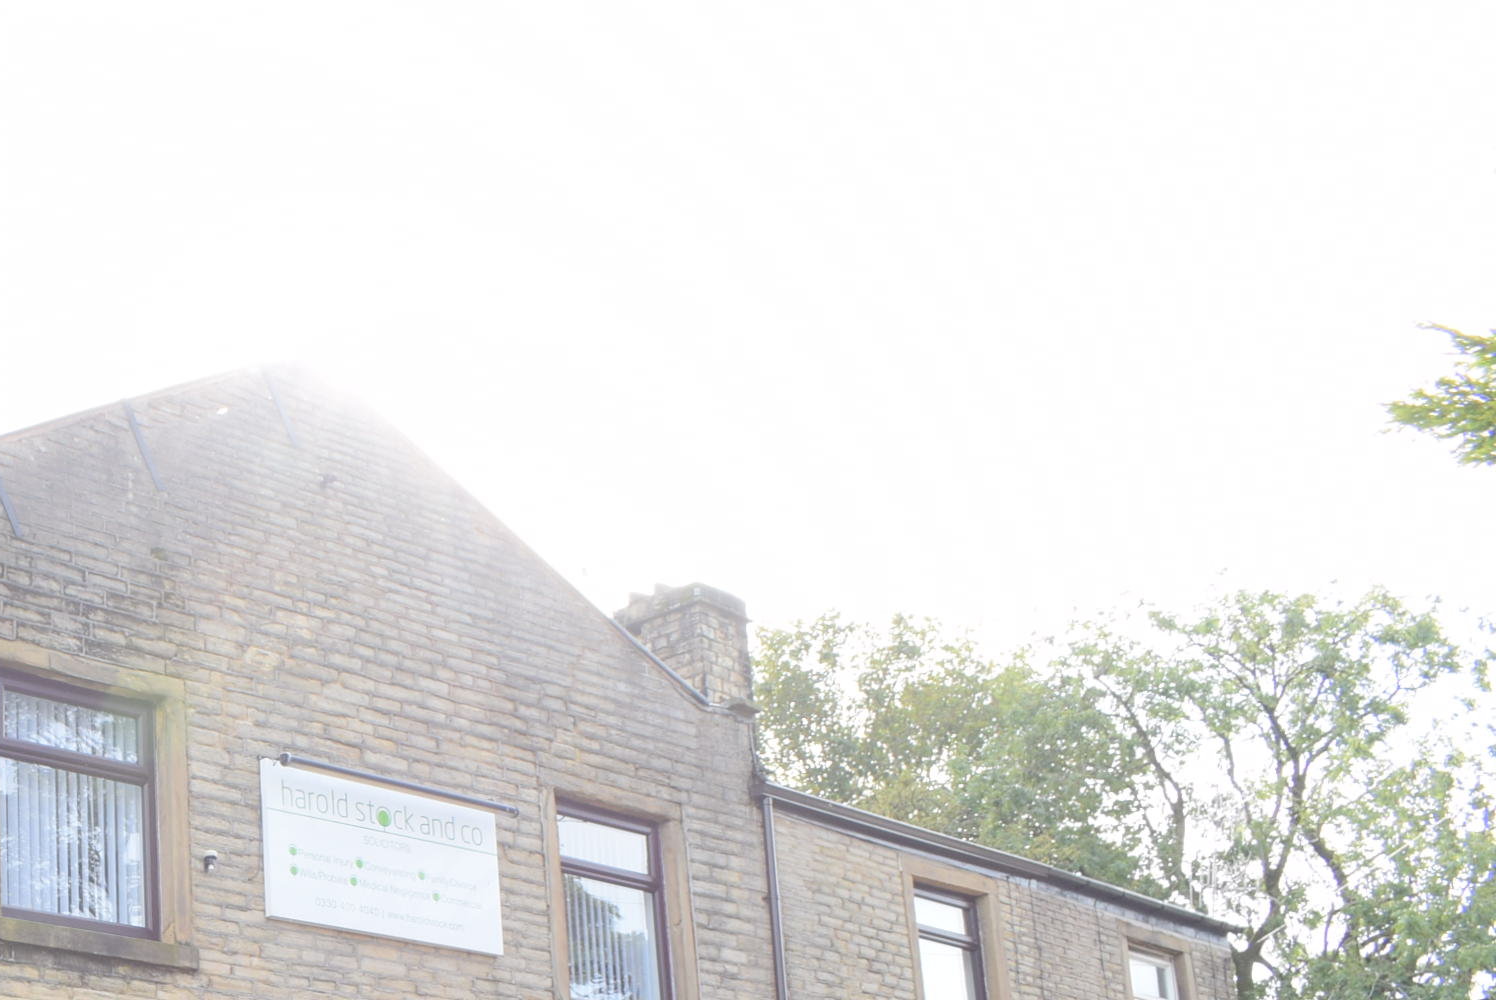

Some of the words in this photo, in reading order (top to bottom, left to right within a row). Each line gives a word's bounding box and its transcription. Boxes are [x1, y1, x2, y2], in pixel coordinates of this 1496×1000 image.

[280, 778, 349, 819] harold
[354, 799, 415, 833] stock
[419, 814, 456, 842] and
[460, 824, 484, 847] co
